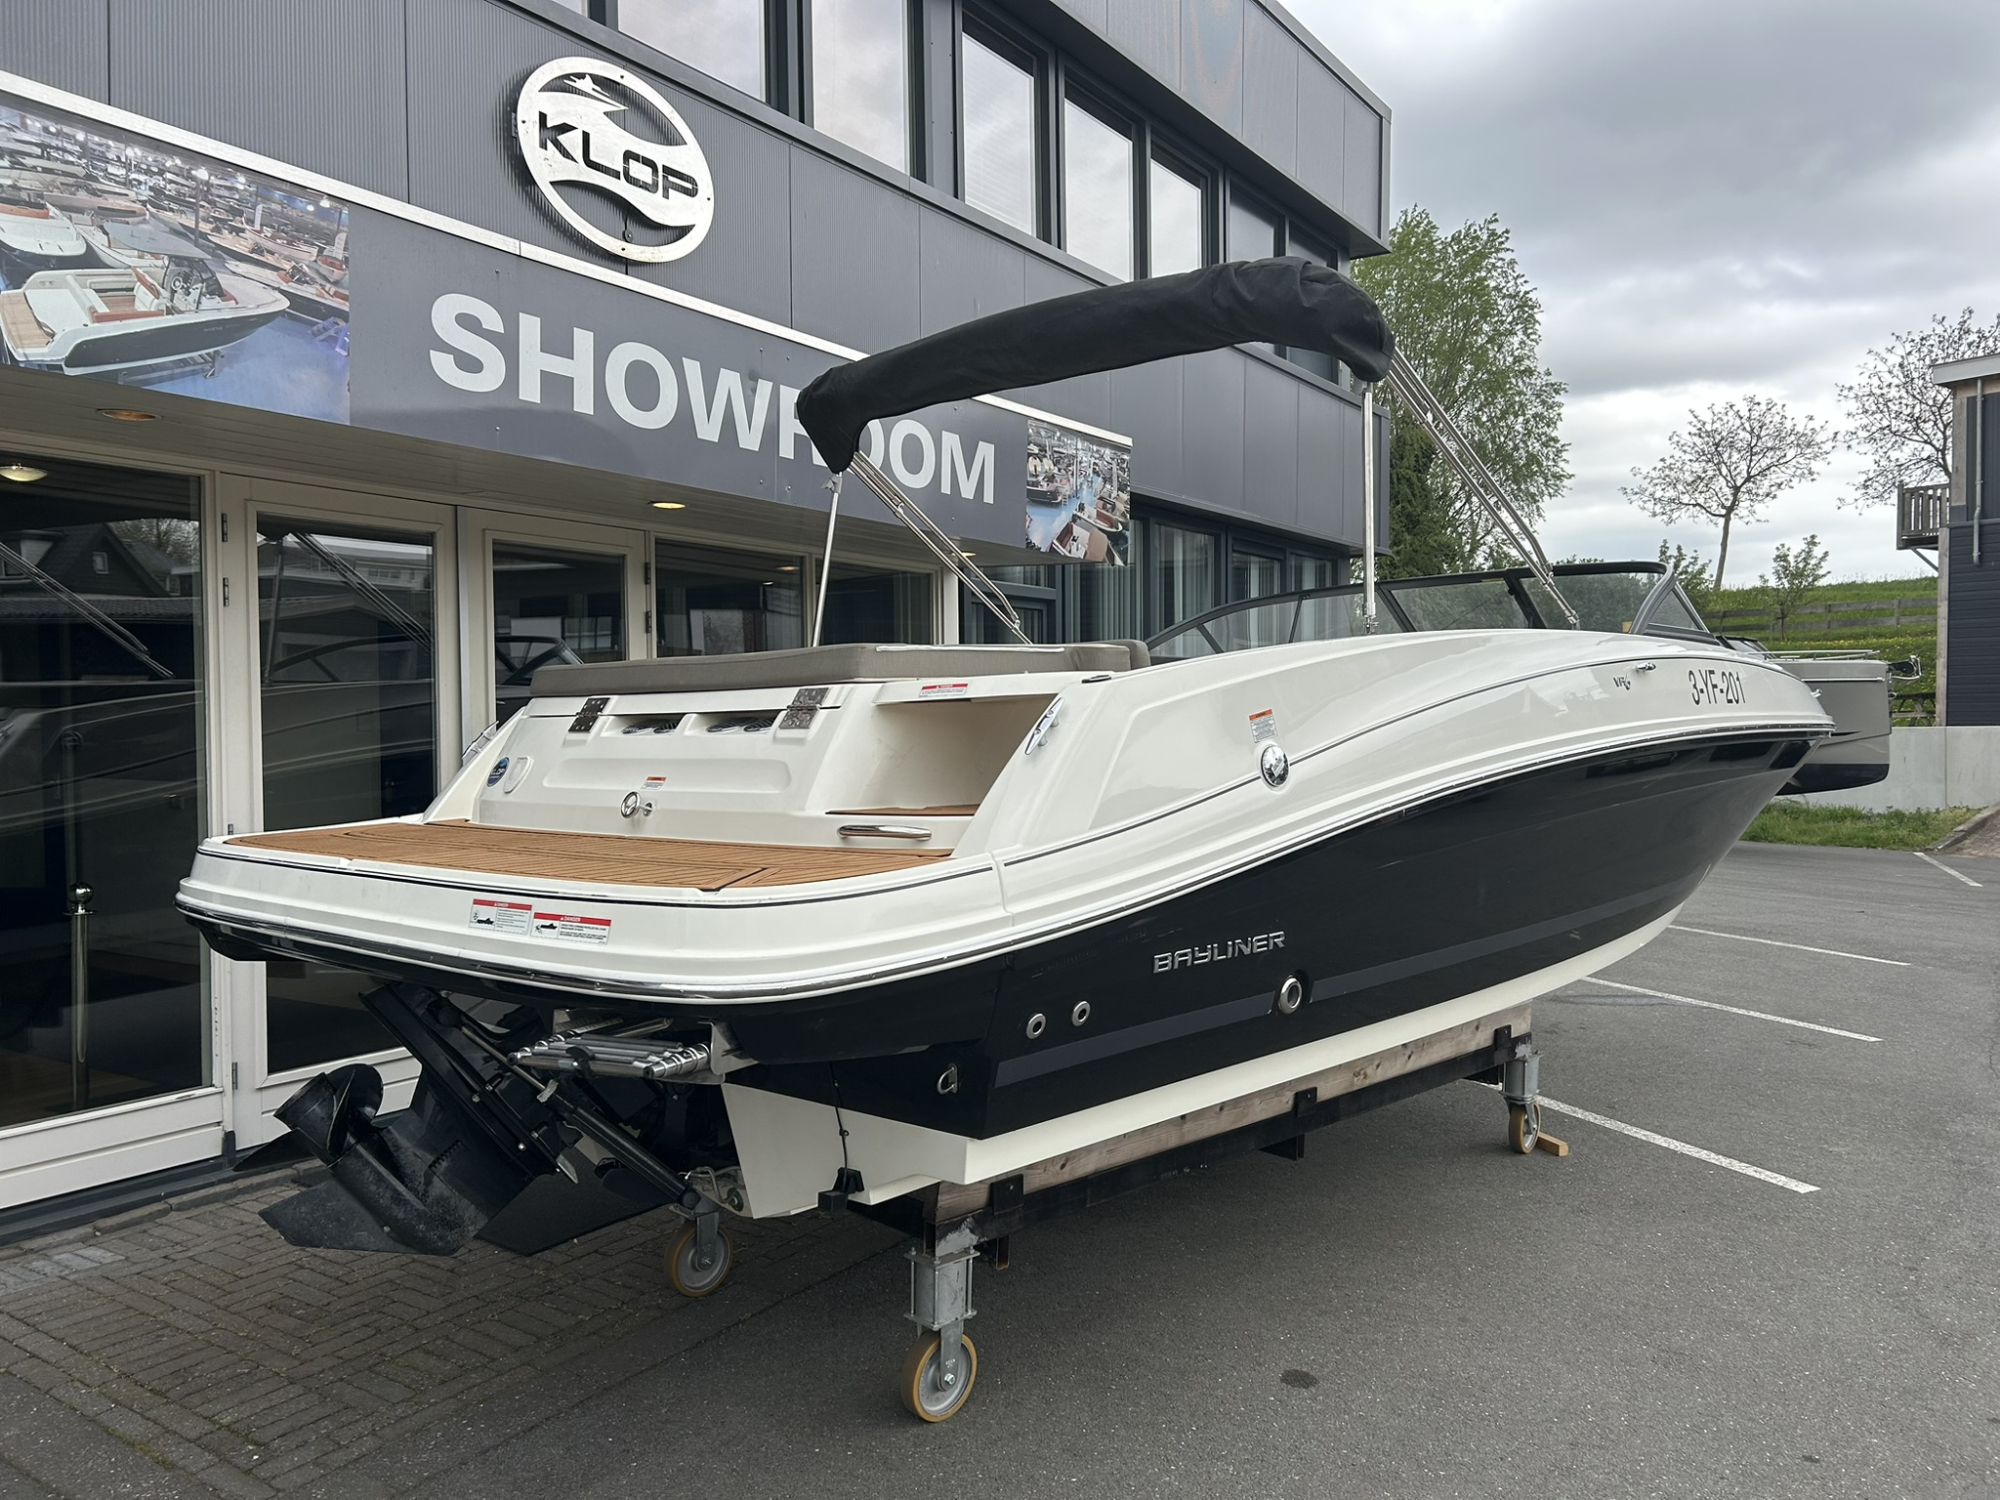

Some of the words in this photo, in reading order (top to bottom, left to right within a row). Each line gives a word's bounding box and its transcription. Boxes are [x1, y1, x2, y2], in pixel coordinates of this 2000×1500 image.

[538, 110, 699, 200] KLOP
[1688, 669, 1746, 705] 3-YF-201
[1153, 931, 1285, 974] BAYLINER
